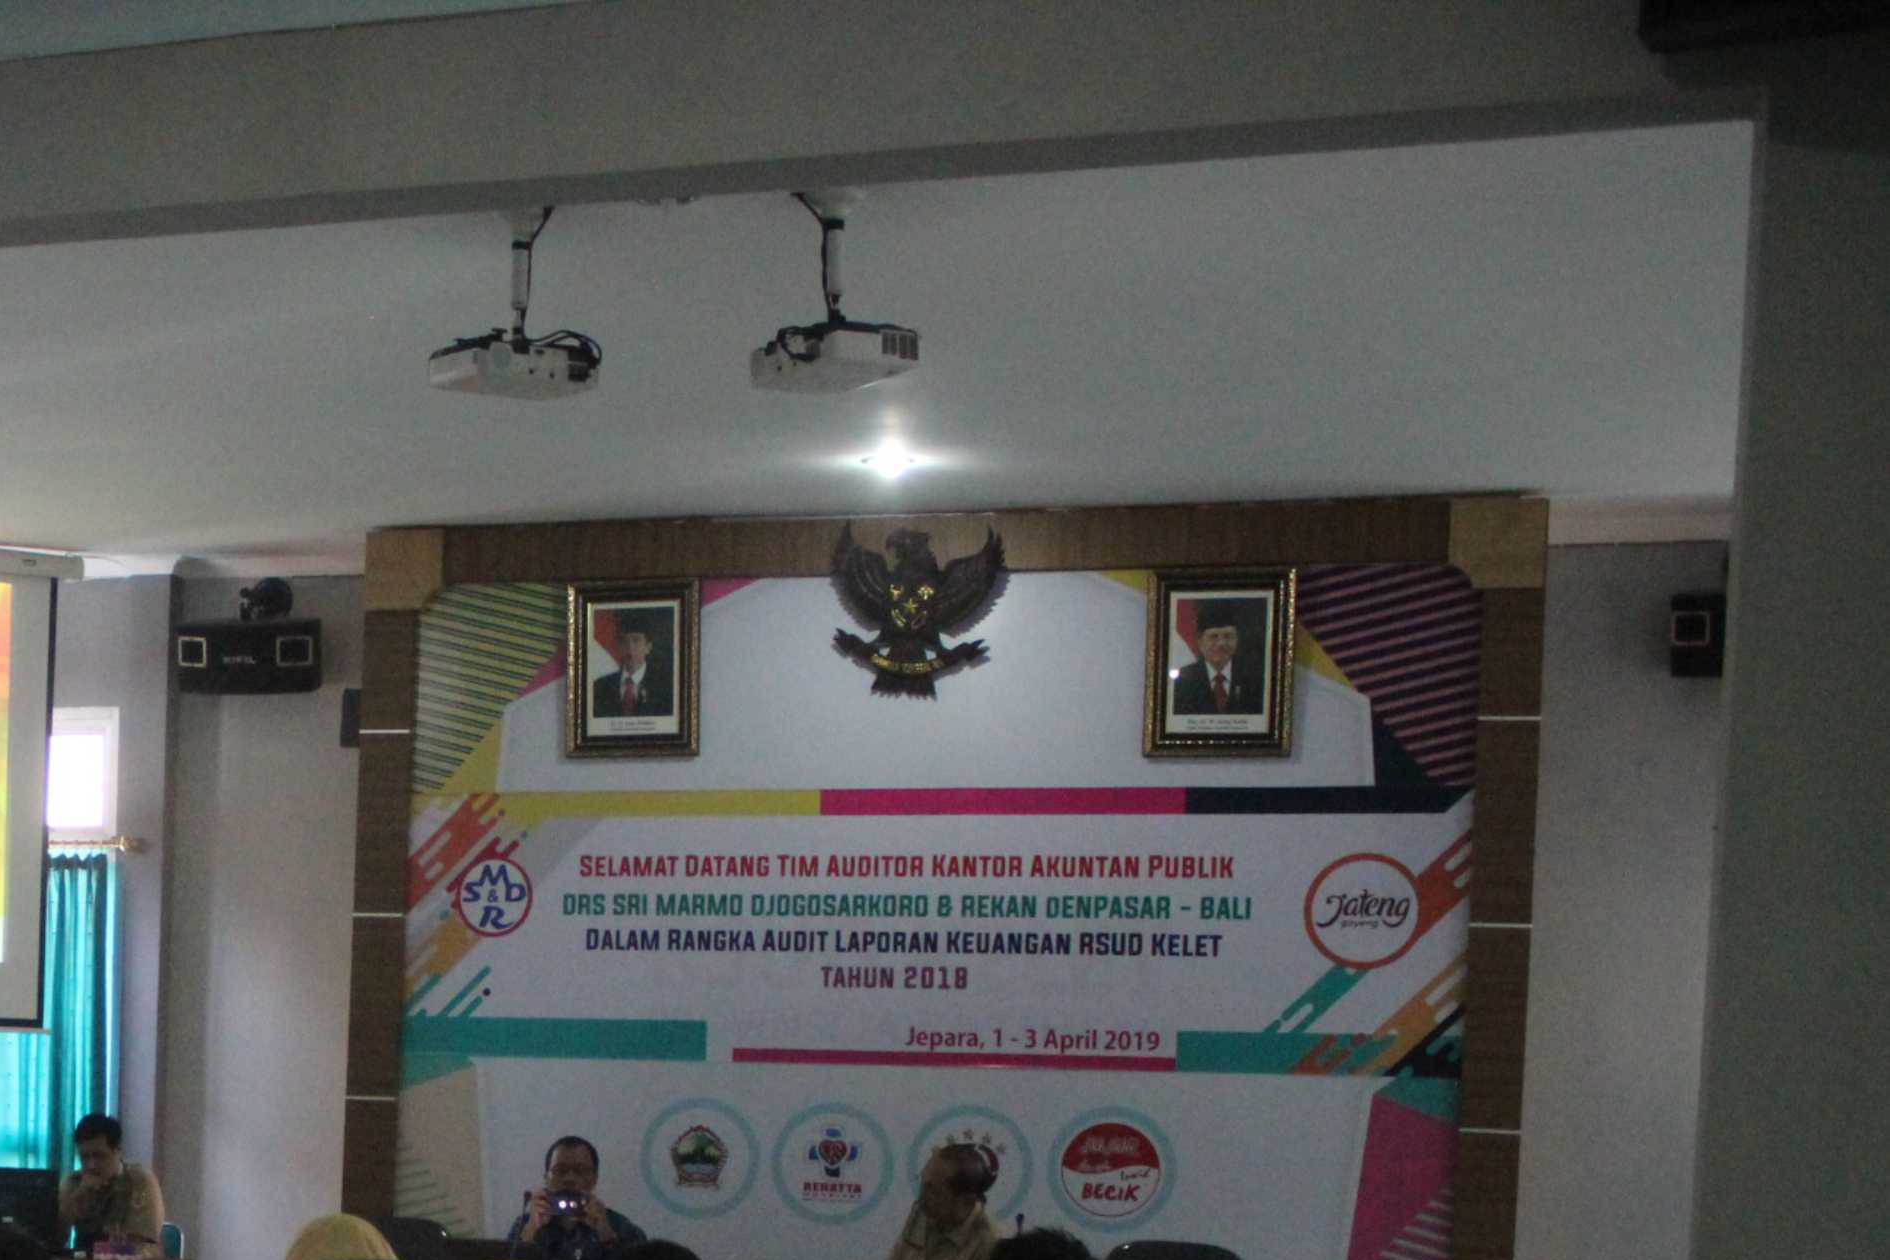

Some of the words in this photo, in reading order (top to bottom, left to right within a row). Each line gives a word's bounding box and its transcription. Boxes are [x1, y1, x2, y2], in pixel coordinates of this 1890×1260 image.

[580, 854, 679, 877] SELAMAT
[685, 854, 770, 877] DATANG
[776, 854, 819, 877] TIM
[826, 854, 923, 877] AUDITOR
[932, 854, 1022, 878] KANTOR
[1030, 854, 1140, 878] AKUNTAN
[1148, 854, 1235, 878] PUBLIK
[563, 893, 606, 916] DRS
[612, 893, 648, 916] SRI
[655, 893, 744, 917] MARMO
[751, 893, 929, 918] DJOGOSARKORO
[937, 895, 953, 918] &
[960, 895, 1037, 919] REKAN
[1046, 896, 1171, 919] DENPASAR
[1200, 897, 1252, 920] BALI
[1315, 888, 1411, 929] Jateng
[586, 928, 660, 951] DALAM
[667, 929, 756, 952] RANGKA
[762, 929, 829, 953] AUDIT
[835, 930, 939, 954] LAPORAN
[946, 931, 1071, 955] KEUANGAN
[1079, 933, 1143, 956] RSUD
[1151, 933, 1223, 957] KELET
[821, 966, 894, 988] TAHUN
[903, 966, 968, 990] 2018
[906, 1026, 985, 1051] Jepara,
[993, 1028, 1003, 1048] 1
[1025, 1029, 1037, 1048] 3
[1044, 1029, 1097, 1052] April
[1105, 1030, 1160, 1050] 2019
[1081, 1182, 1141, 1202] BECIK
